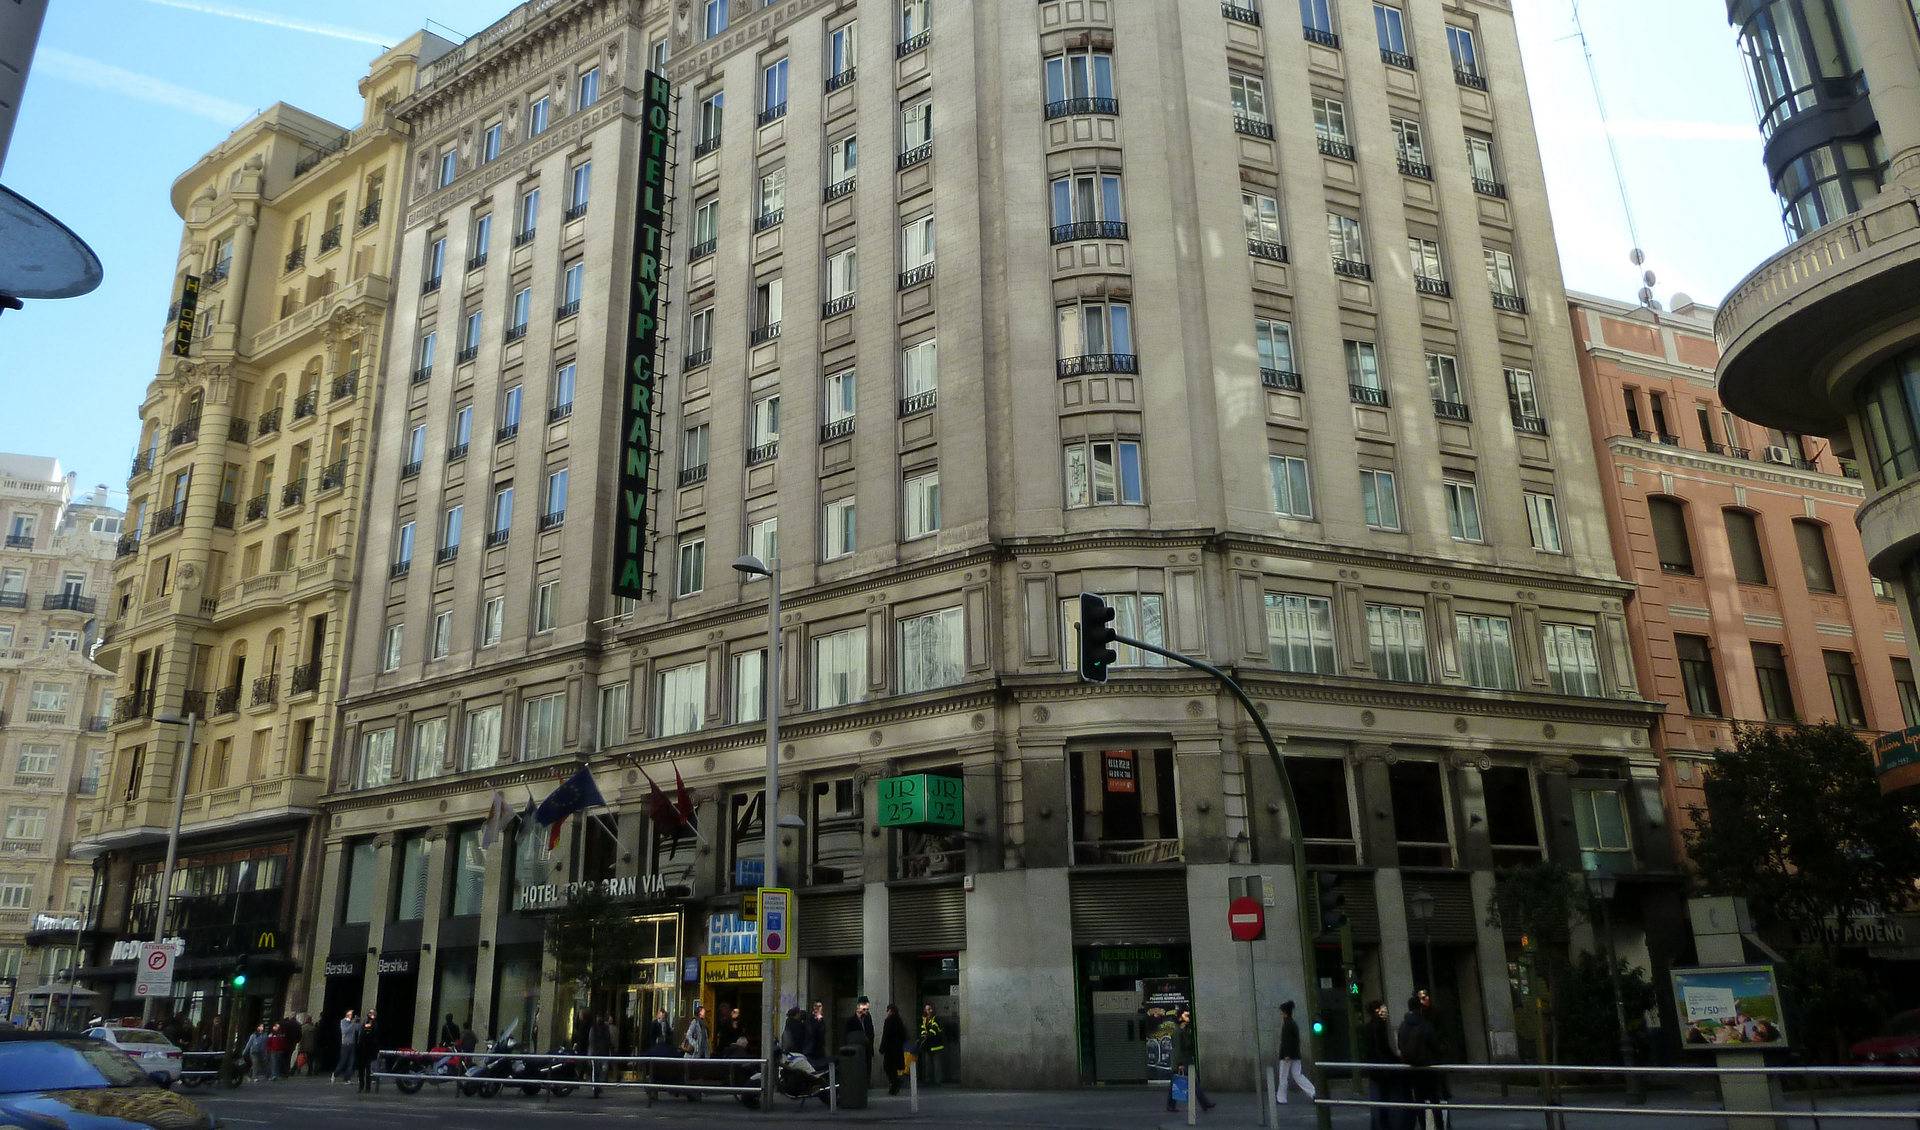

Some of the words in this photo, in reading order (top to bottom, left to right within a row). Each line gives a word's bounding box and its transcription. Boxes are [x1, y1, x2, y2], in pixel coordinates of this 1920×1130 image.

[646, 77, 669, 212] HOTEL
[636, 224, 660, 339] TRYP
[627, 354, 651, 478] GRAN
[619, 499, 645, 589] VIA
[888, 800, 914, 821] 25
[934, 801, 955, 821] 25
[520, 883, 558, 903] HOTEL
[642, 873, 665, 895] VIA
[325, 961, 354, 975] Bershka
[377, 959, 408, 974] Bershka
[728, 963, 759, 972] WESTERN
[737, 970, 759, 978] UNION
